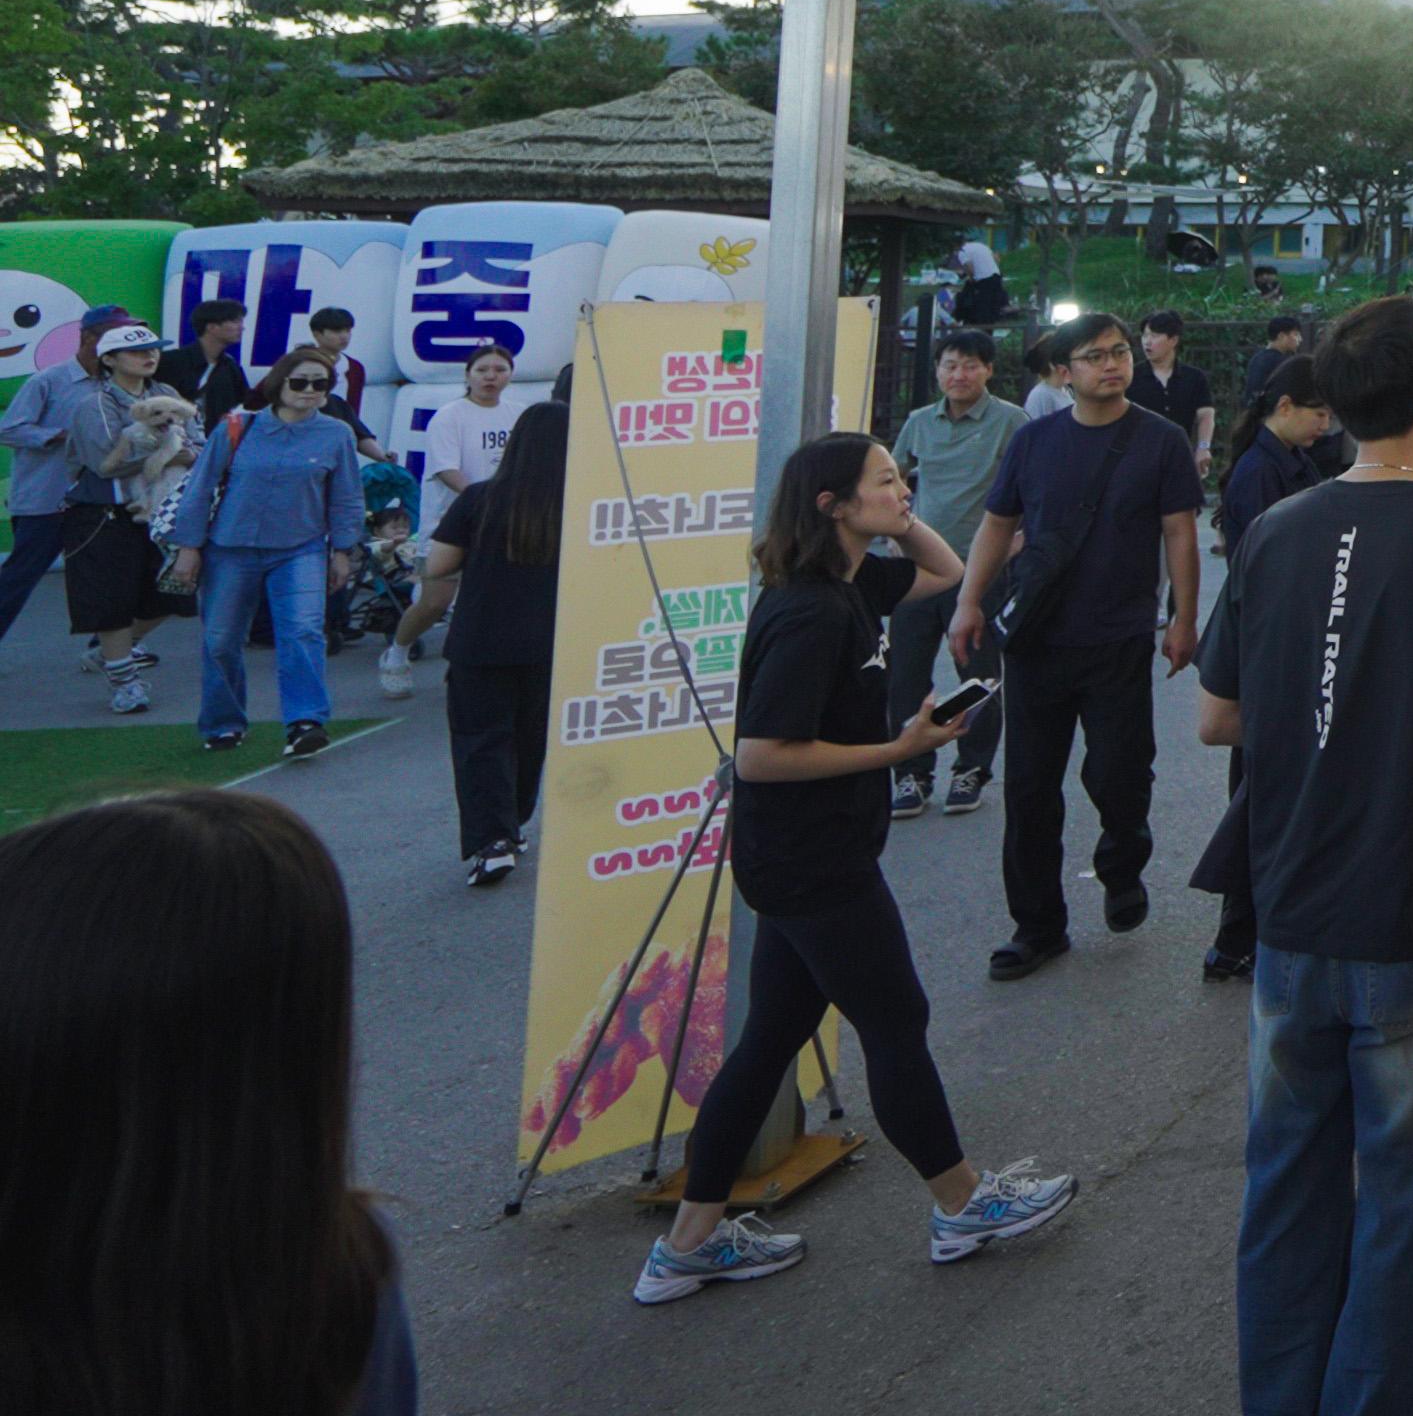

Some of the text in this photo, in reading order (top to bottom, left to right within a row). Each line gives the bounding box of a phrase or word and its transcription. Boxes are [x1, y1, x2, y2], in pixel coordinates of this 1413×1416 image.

[482, 430, 514, 450] 198
[1318, 526, 1357, 750] TRAIL RATED
